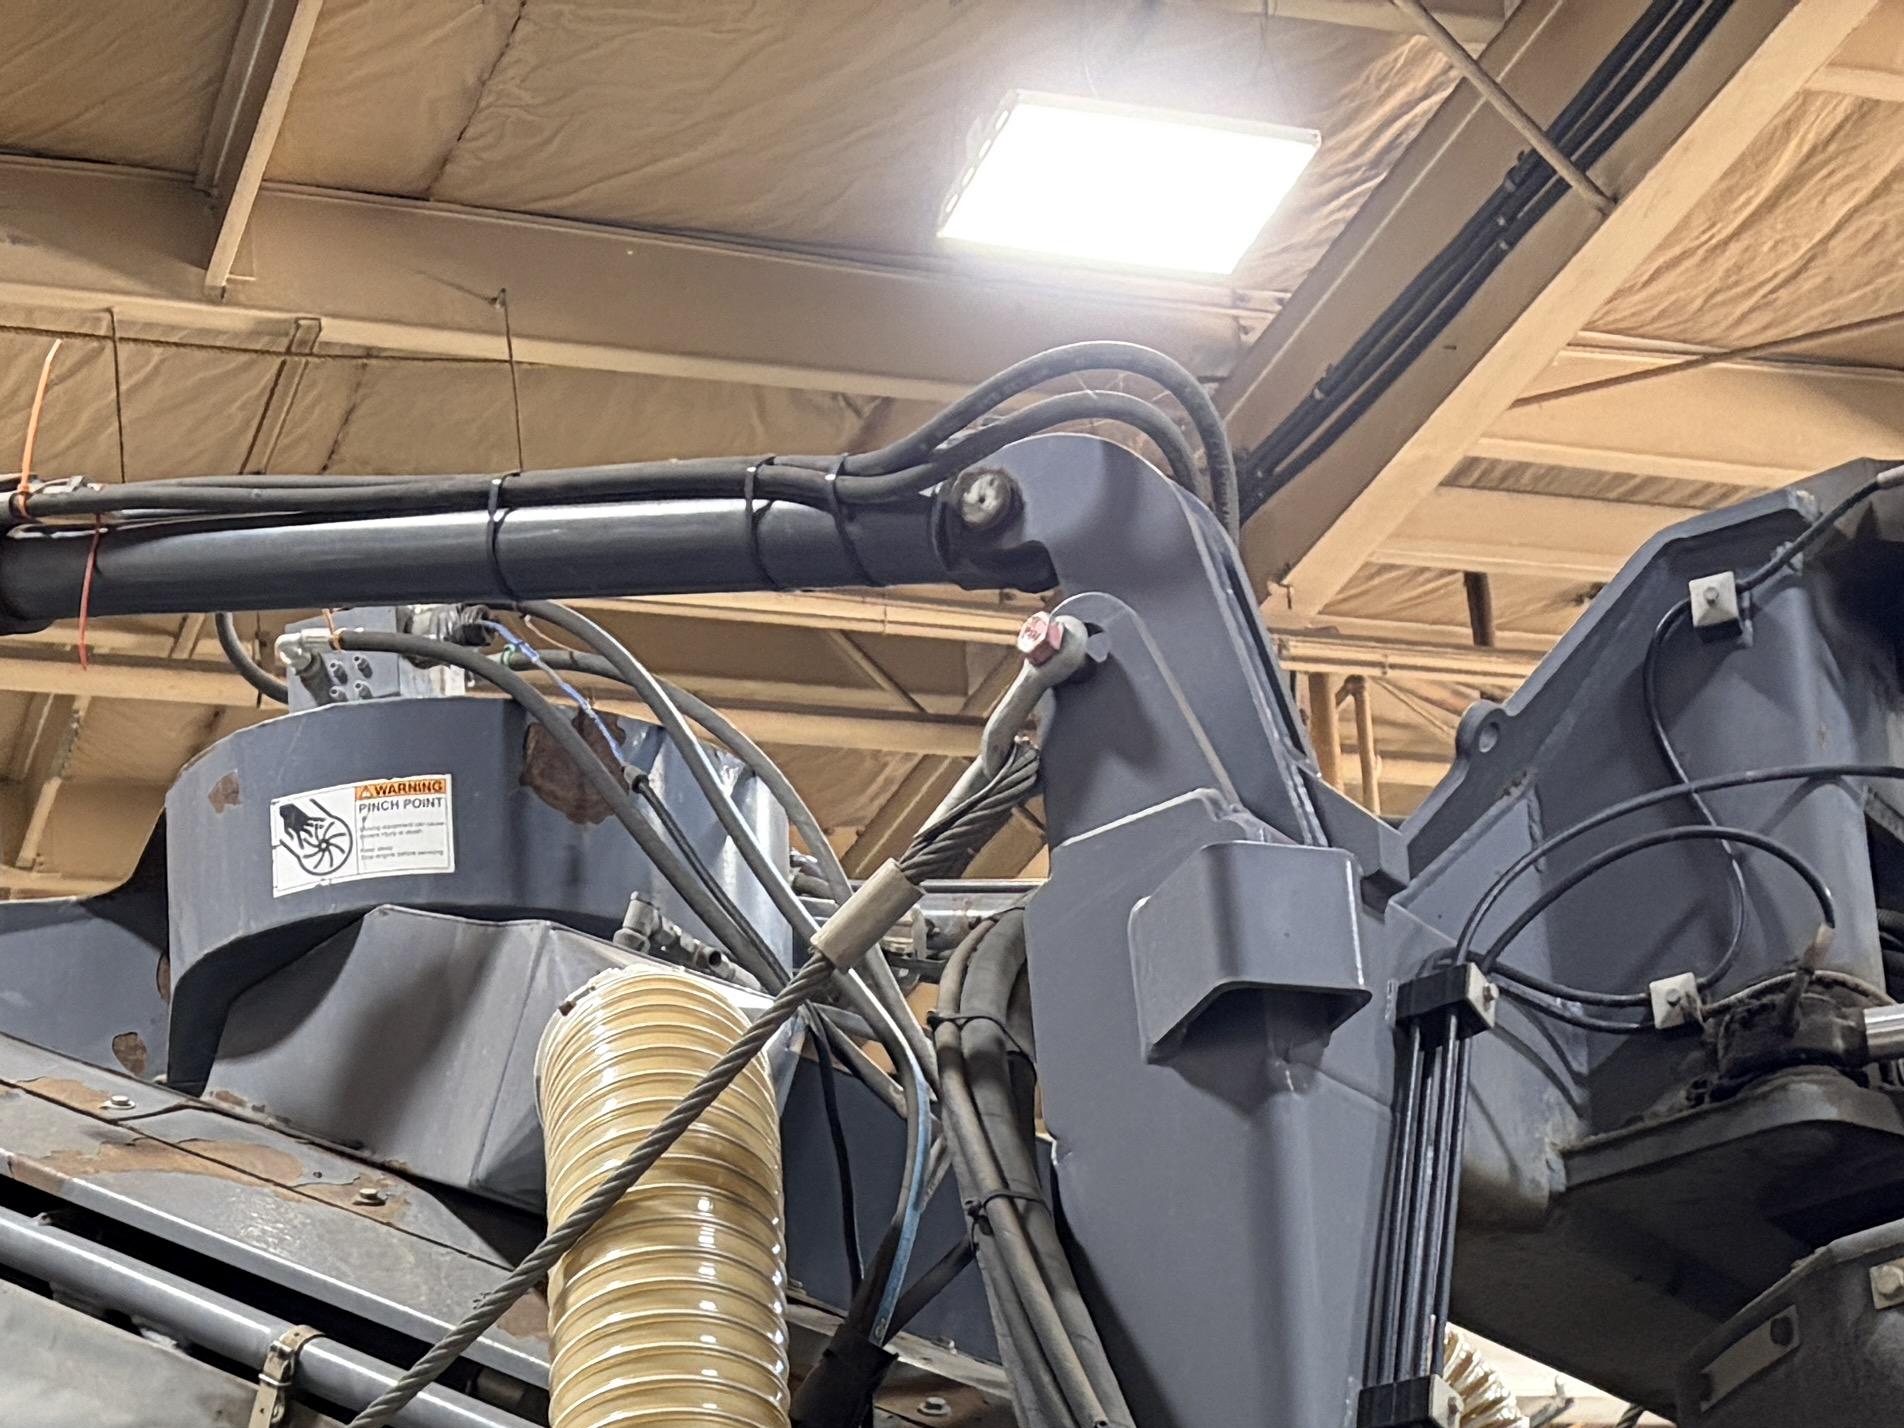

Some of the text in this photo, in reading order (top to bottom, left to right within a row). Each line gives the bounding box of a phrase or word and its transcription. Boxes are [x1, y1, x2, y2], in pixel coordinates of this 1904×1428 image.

[375, 780, 443, 796] WARNING
[358, 797, 443, 814] PINCH POINT
